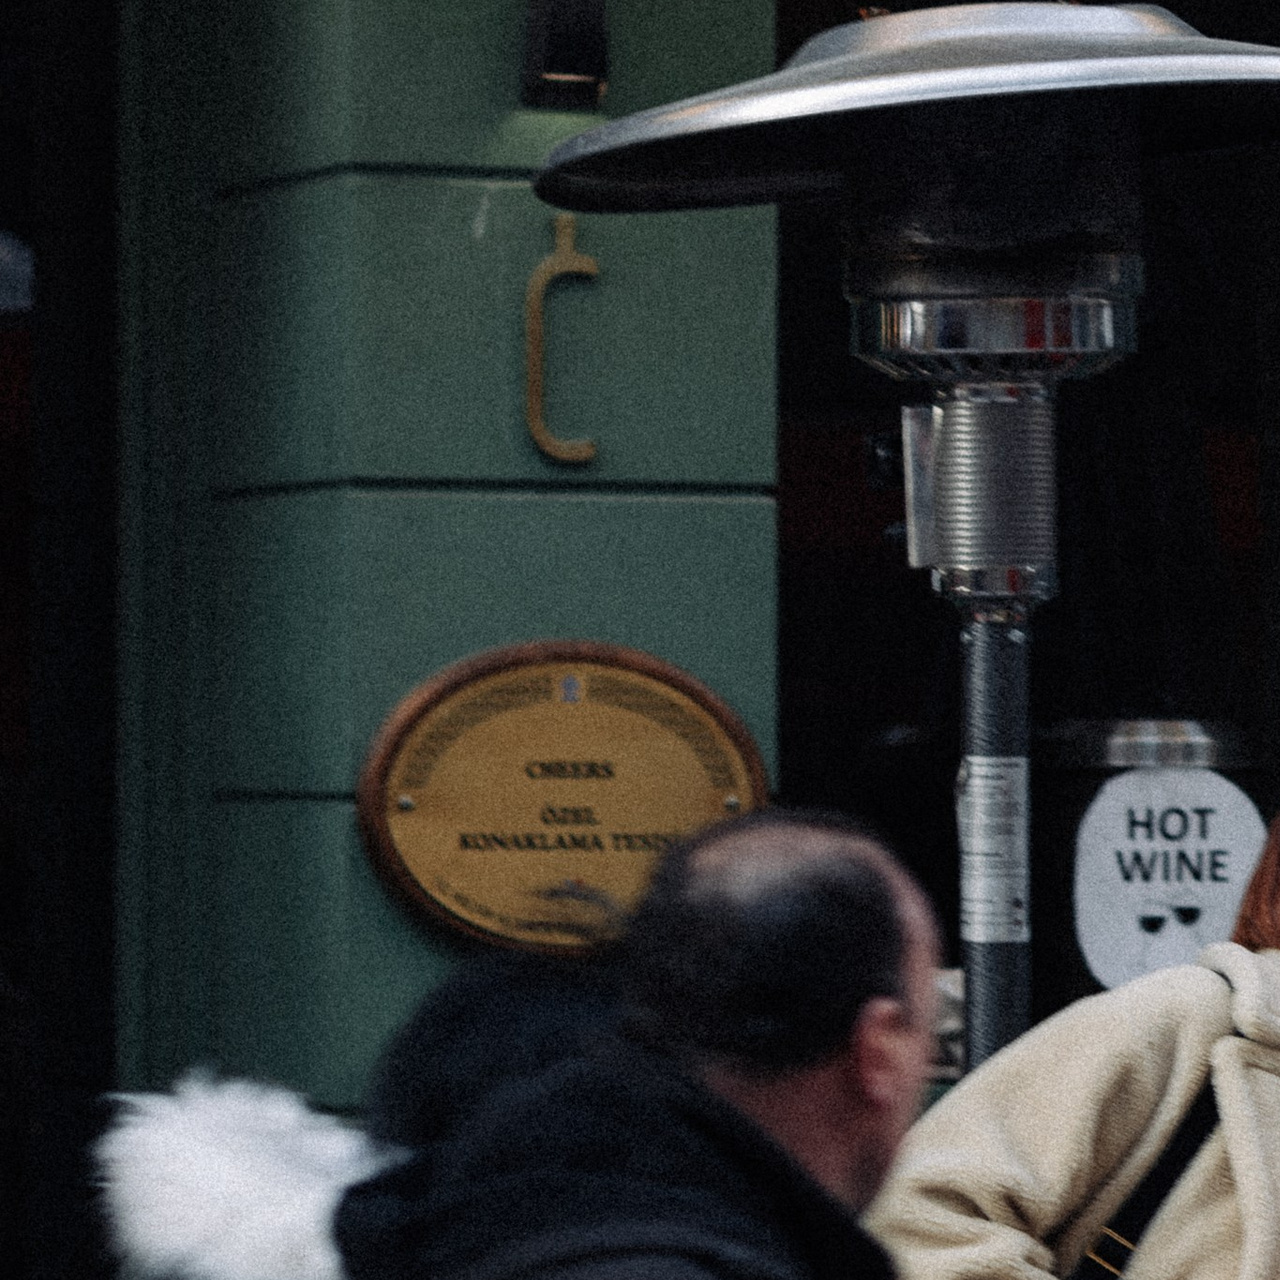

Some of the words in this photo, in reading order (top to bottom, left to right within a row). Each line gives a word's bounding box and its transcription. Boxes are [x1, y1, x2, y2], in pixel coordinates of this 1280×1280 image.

[525, 761, 615, 780] CHEERS
[1126, 806, 1217, 842] HOT
[1115, 849, 1230, 884] WINE
